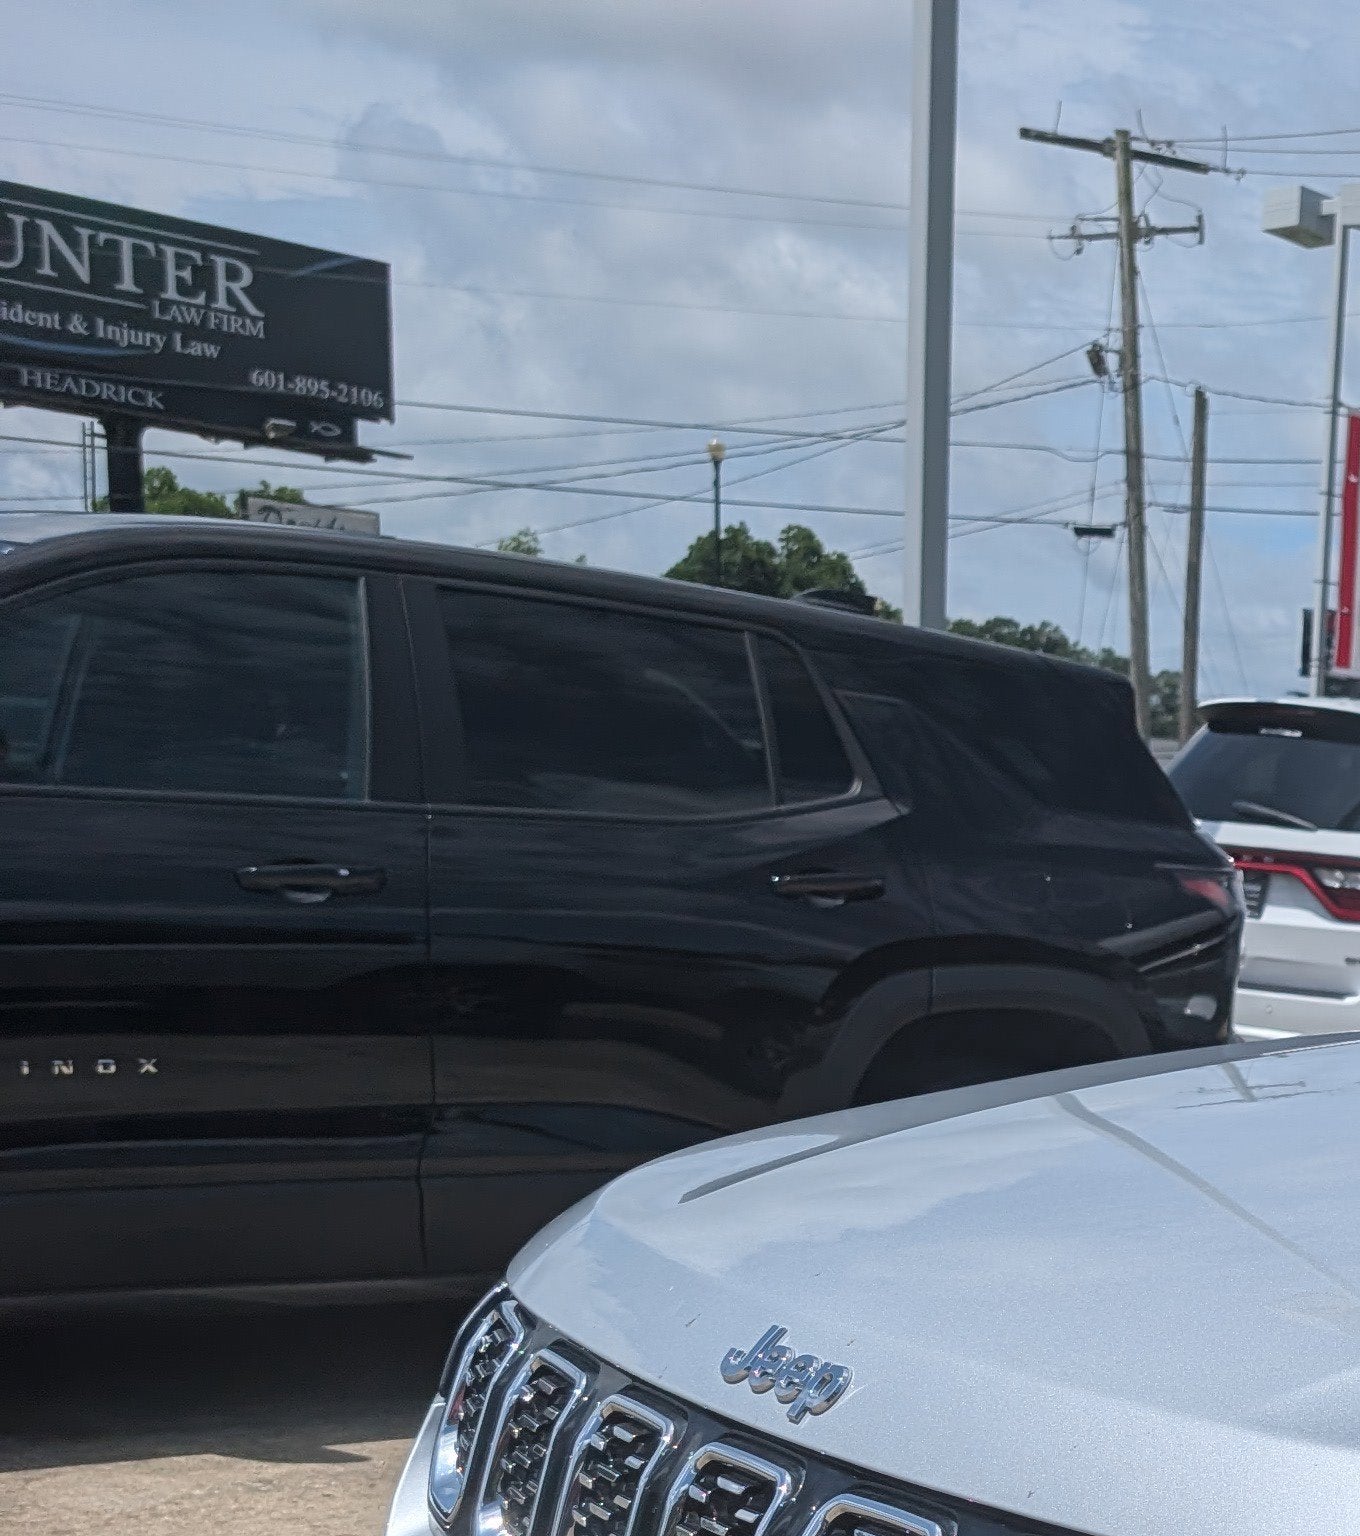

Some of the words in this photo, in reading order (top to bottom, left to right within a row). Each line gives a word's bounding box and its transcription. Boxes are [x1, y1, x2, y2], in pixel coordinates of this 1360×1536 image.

[68, 313, 90, 336] &
[96, 317, 167, 353] Injury
[172, 332, 221, 358] Law
[153, 300, 205, 325] LAW
[209, 311, 265, 339] FIRM
[20, 366, 165, 410] HEADRICK
[720, 1325, 853, 1425] Jeep
